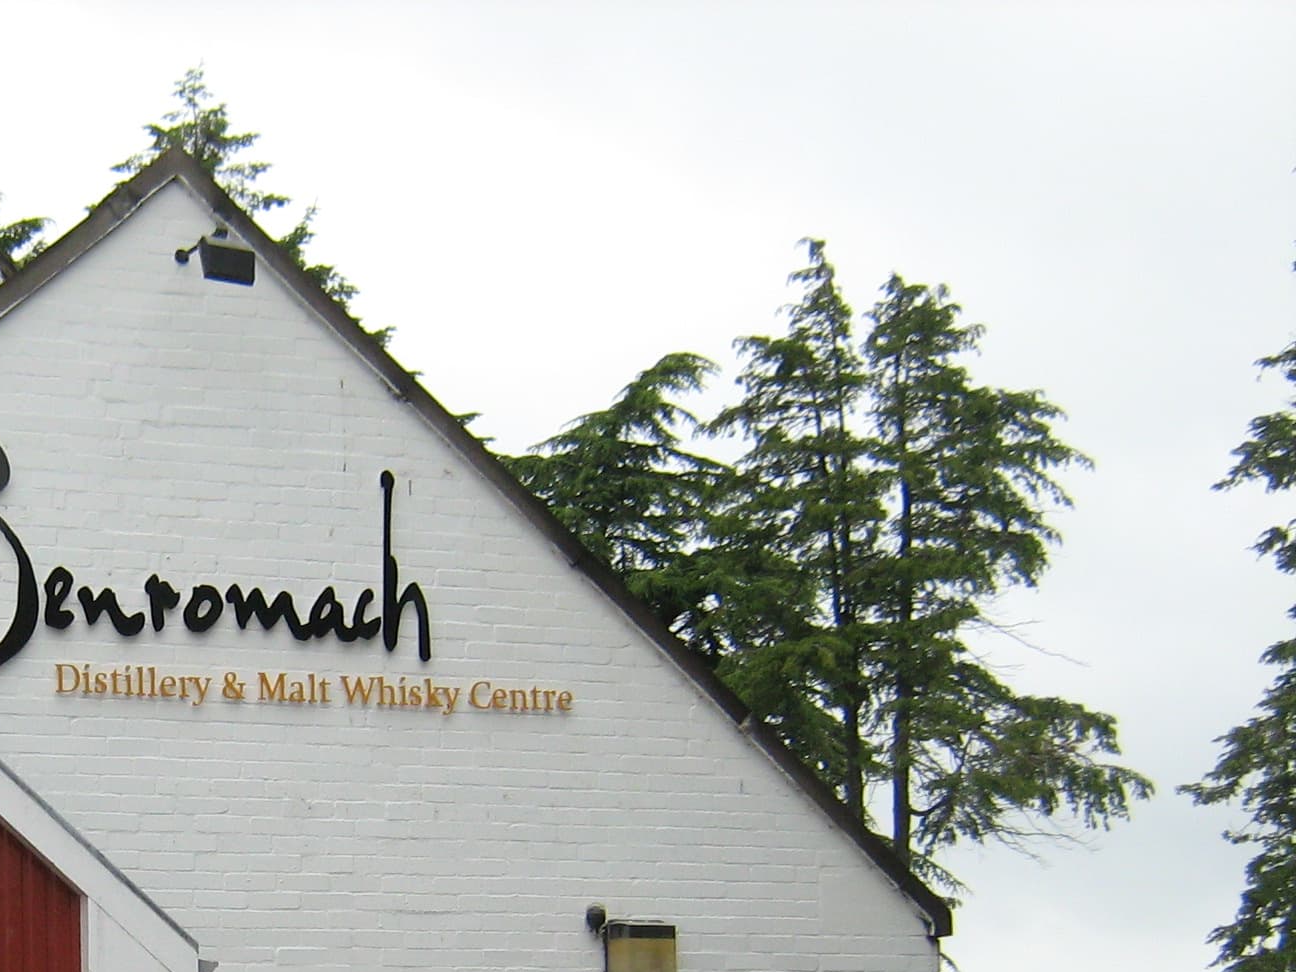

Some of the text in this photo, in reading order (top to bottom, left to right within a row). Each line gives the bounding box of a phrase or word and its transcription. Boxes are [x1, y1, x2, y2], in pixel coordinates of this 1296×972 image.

[54, 663, 573, 715] Distillery & Malt Whisky Centre
